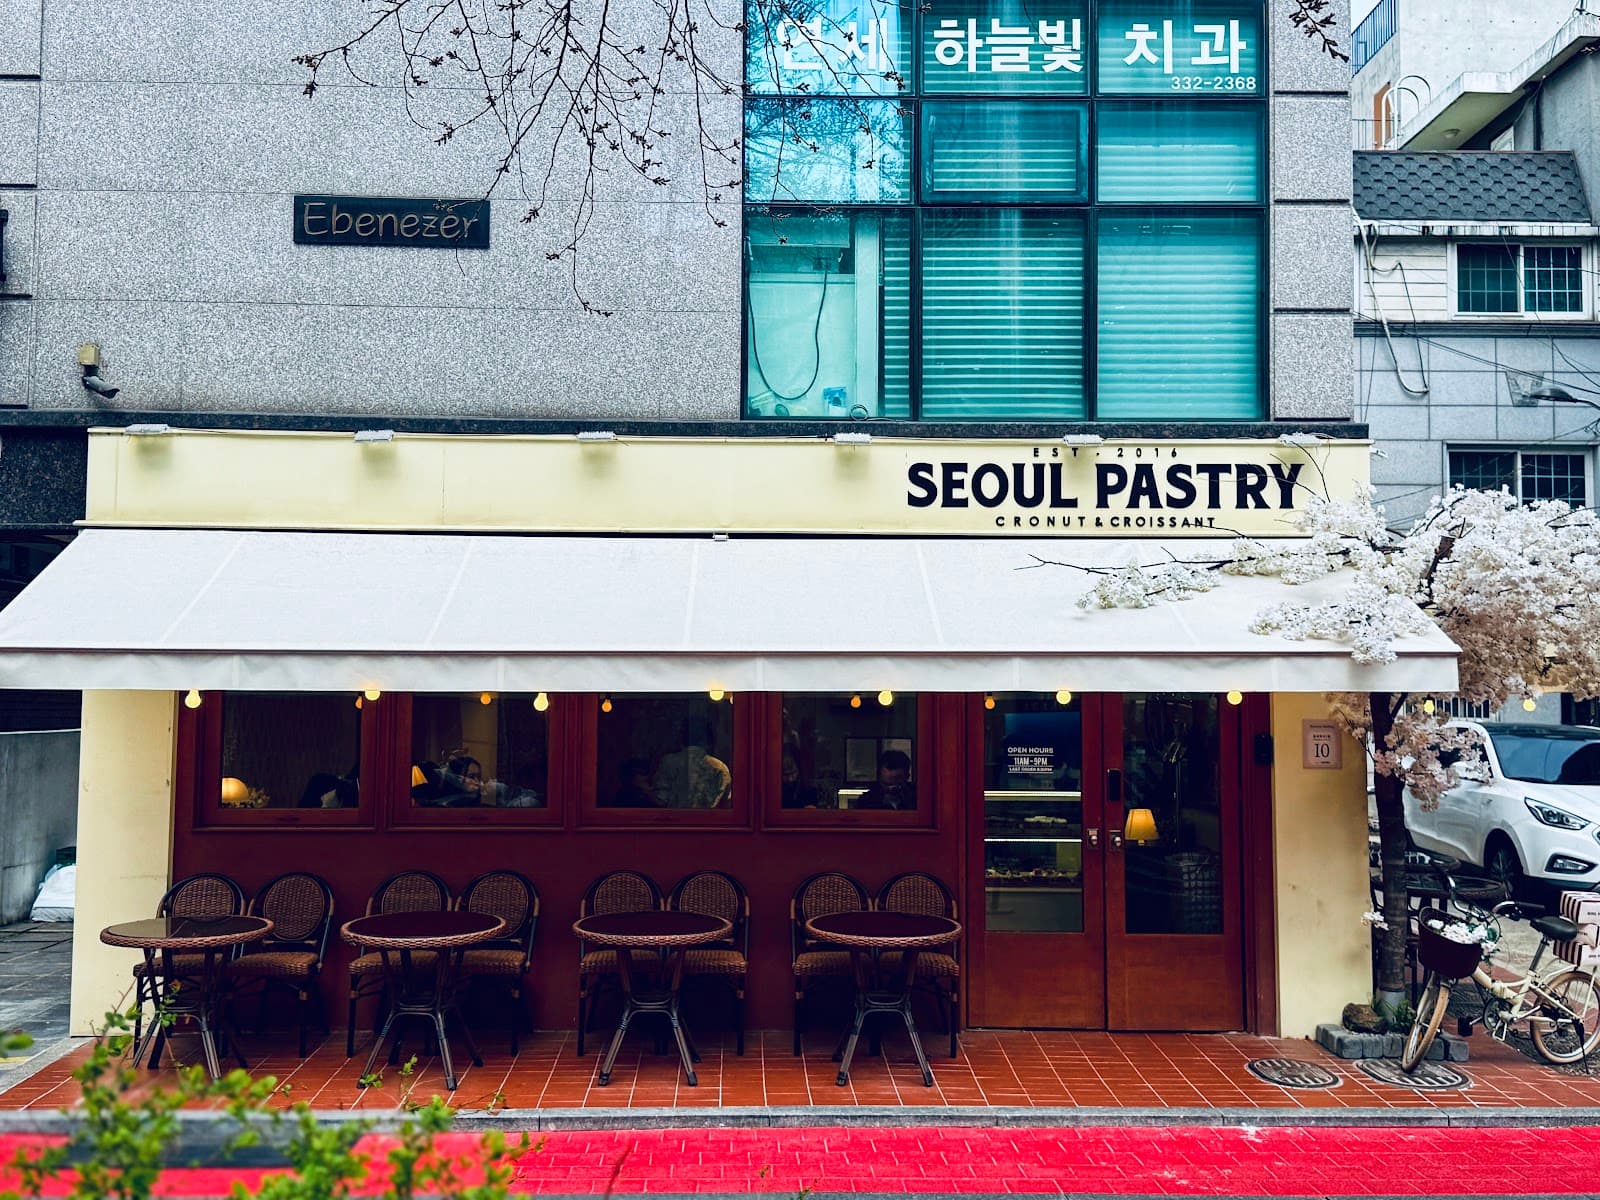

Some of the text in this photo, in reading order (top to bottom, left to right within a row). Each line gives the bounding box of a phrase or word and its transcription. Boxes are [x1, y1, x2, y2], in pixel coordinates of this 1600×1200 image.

[776, 17, 1247, 74] 연세 하늘빛 치과
[1170, 76, 1256, 91] 332-2368
[303, 202, 478, 238] Ebenezer
[1117, 447, 1178, 458] 2016
[907, 462, 1305, 509] SEOUL PASTRY
[995, 516, 1087, 528] CRONUT
[1110, 516, 1216, 529] CROISSANT
